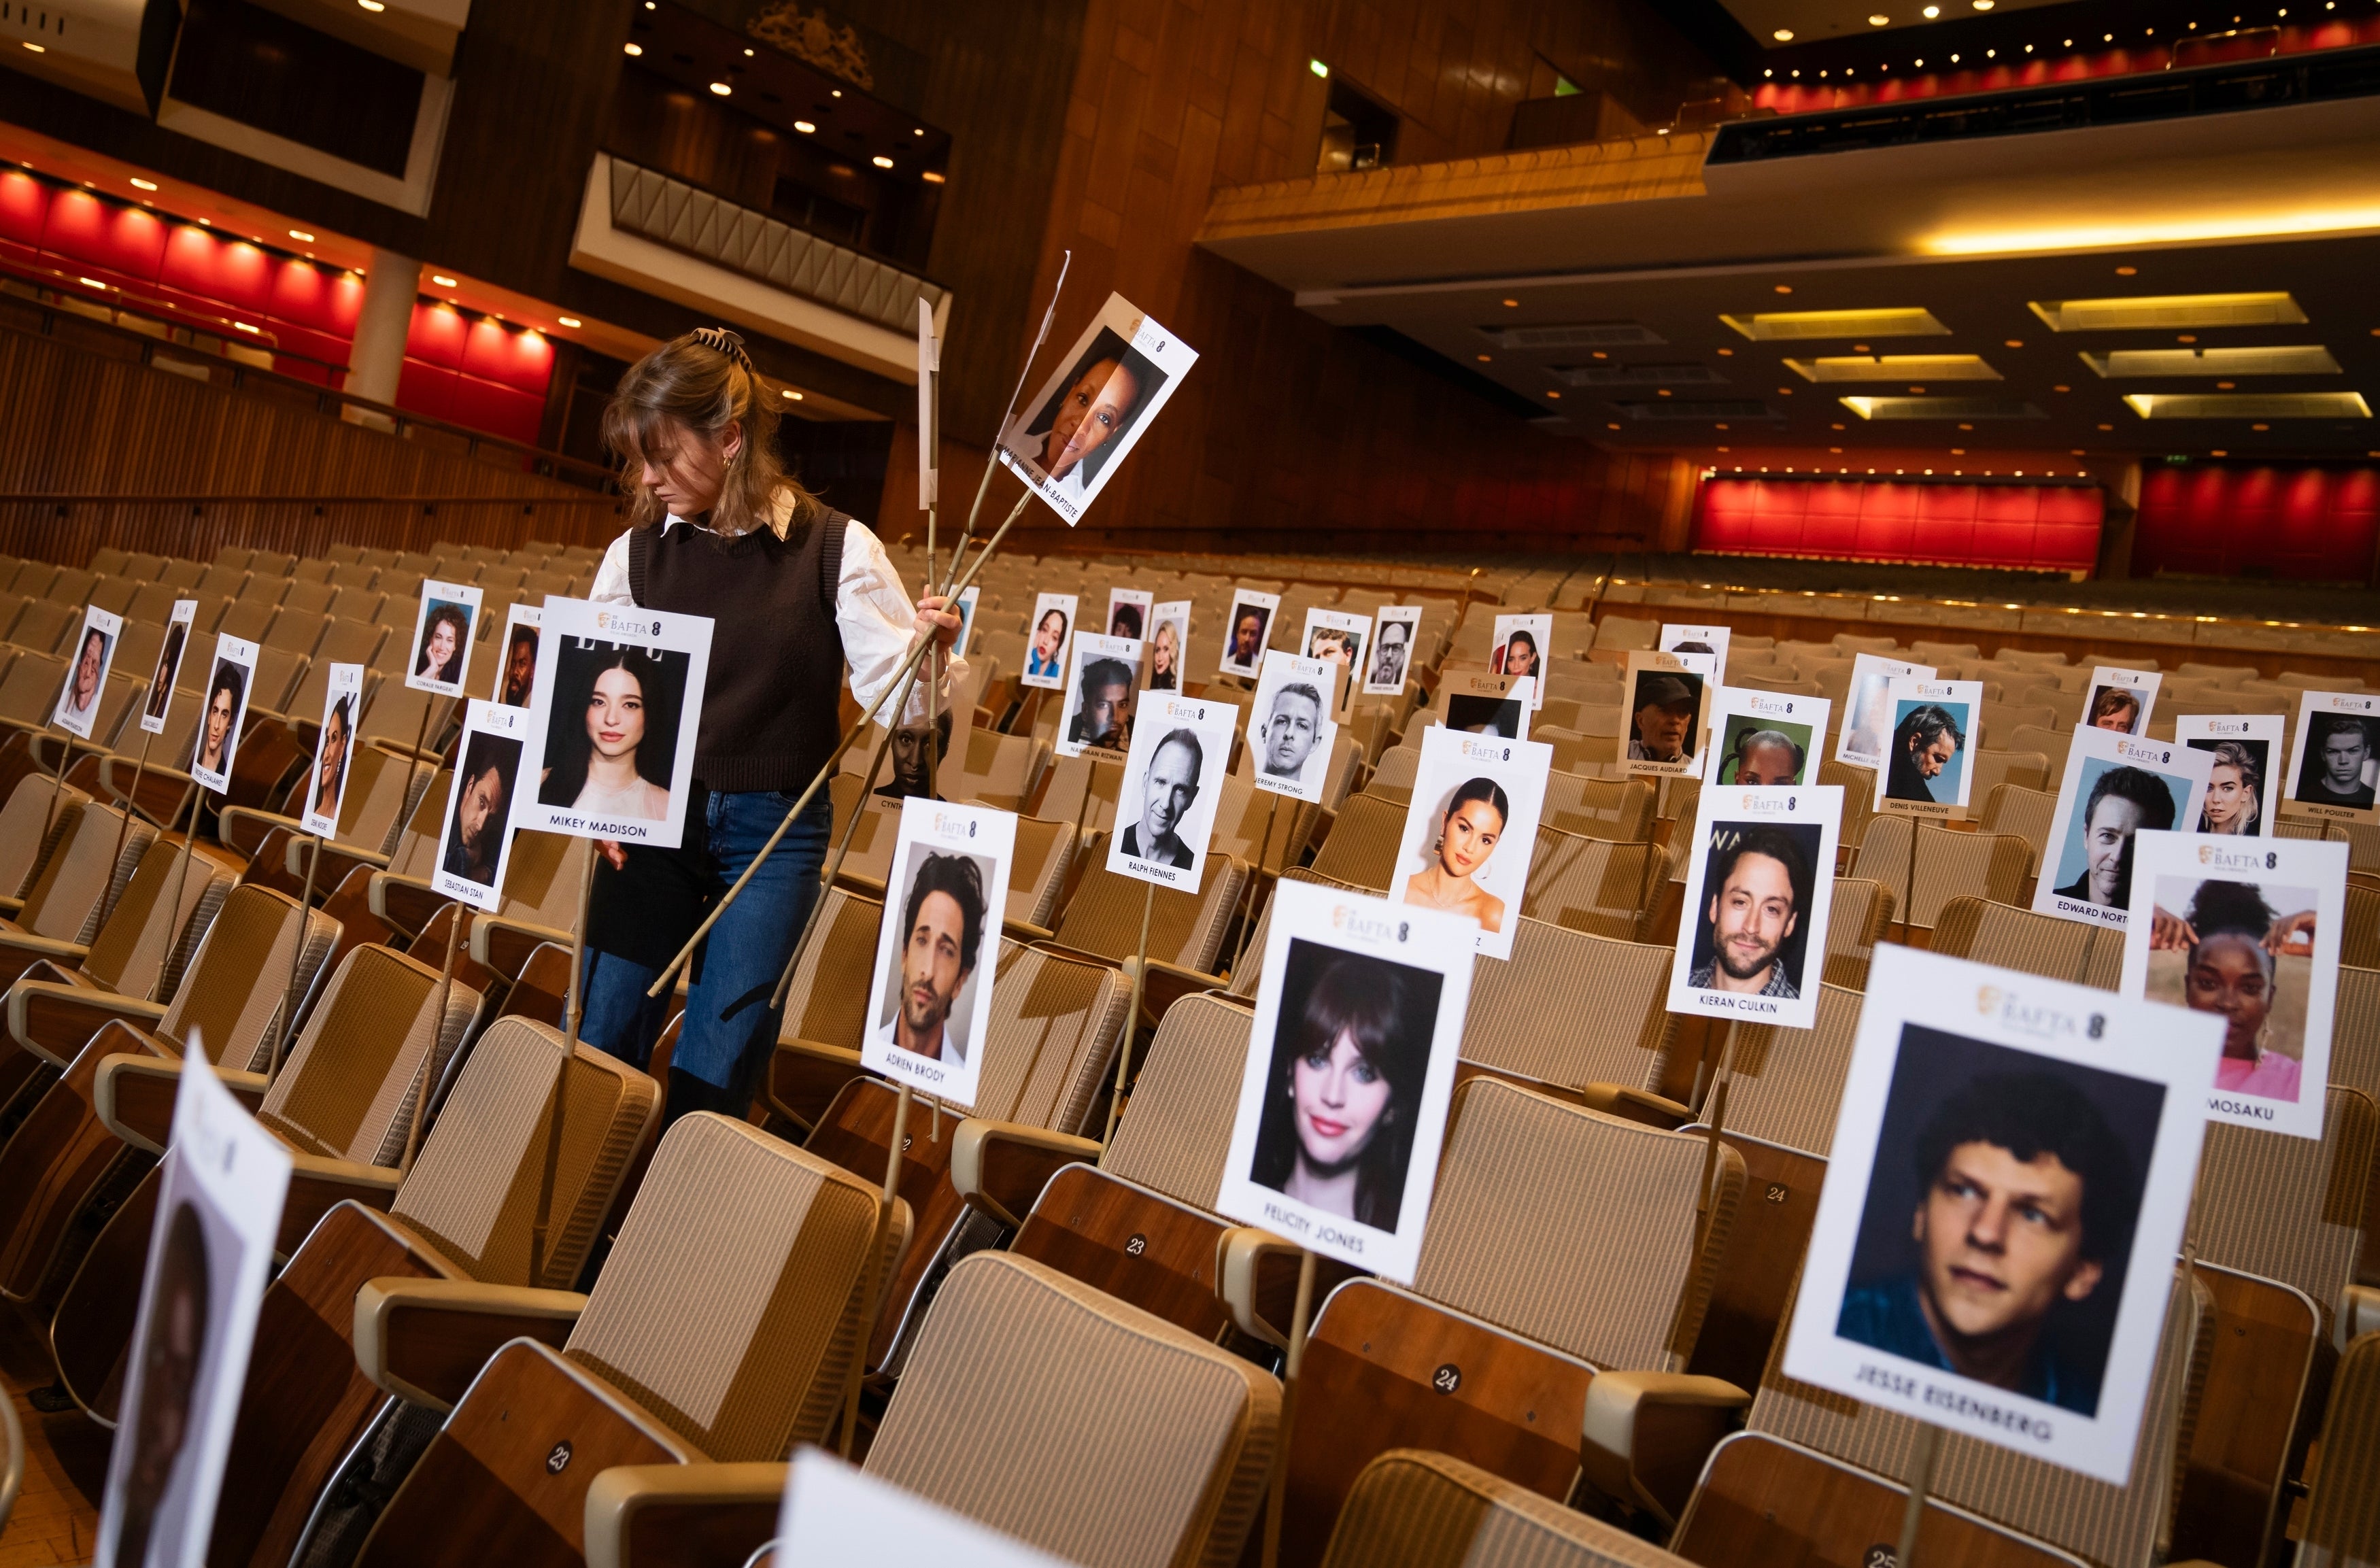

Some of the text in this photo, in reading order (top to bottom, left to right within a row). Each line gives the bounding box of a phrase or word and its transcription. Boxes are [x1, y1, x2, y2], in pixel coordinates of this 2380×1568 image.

[1135, 327, 1156, 347] BAFTA
[1002, 445, 1078, 518] MARIANNE JEAN-BAPTISTE
[611, 620, 647, 634] BAFTA
[1297, 664, 1316, 675] BAFTA
[1477, 682, 1497, 691] BAFTA
[1174, 708, 1195, 719] BAFTA
[1758, 702, 1783, 713] BAFTA
[491, 715, 507, 727] BAFTA
[1070, 747, 1123, 761] NABHAAN RIZWAN
[1471, 747, 1499, 760] BAFTA
[2128, 748, 2158, 762] BAFTA
[1630, 764, 1659, 772] JACQUES
[203, 773, 223, 787] CHALAMET
[1254, 777, 1303, 795] JEREMY STRONG
[881, 800, 902, 810] CYNTH
[1752, 800, 1784, 811] BAFTA
[1890, 802, 1949, 814] DENIS VILLENEUVE
[2324, 809, 2355, 818] POULTER
[549, 815, 647, 837] MIKEY MADISON
[942, 821, 966, 836] BAFTA
[2214, 853, 2259, 869] BAFTA
[1128, 862, 1176, 881] RALPH FIENNES
[445, 879, 483, 900] SEBASTIAN STAN
[2057, 900, 2129, 924] EDWARD NORT
[1699, 994, 1778, 1013] KIERAN CULKIN
[885, 1052, 946, 1083] ADRIEN BRODY
[2207, 1097, 2274, 1121] MOSAKU
[1767, 1187, 1785, 1202] 24
[1264, 1202, 1364, 1254] FELICITY JONES
[1126, 1238, 1145, 1256] 23
[1435, 1369, 1457, 1391] 24
[1854, 1363, 2053, 1444] JESSE EISENBERG
[549, 1446, 570, 1471] 23
